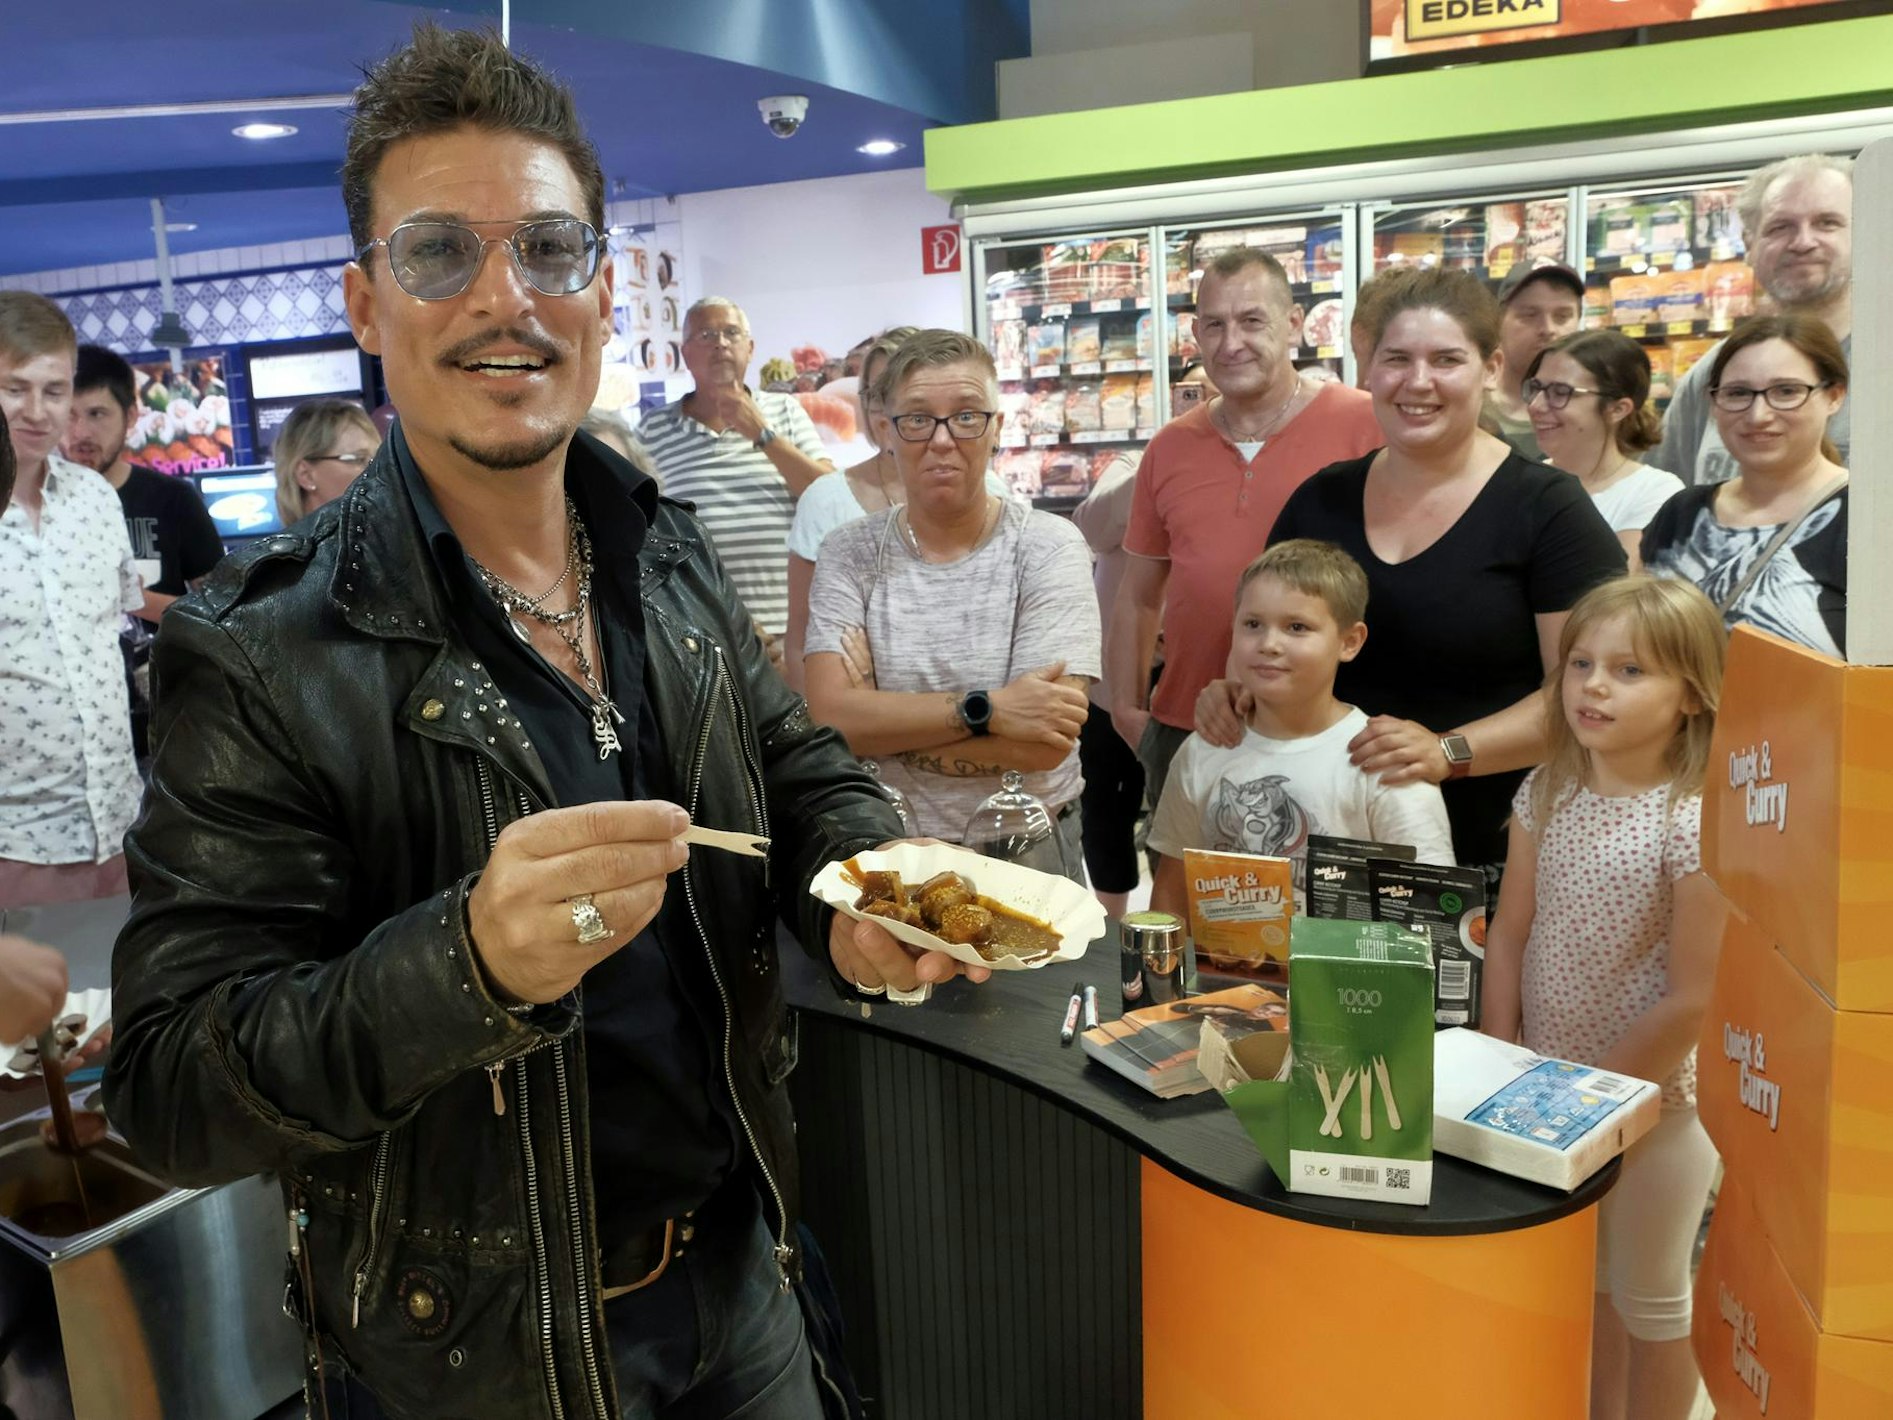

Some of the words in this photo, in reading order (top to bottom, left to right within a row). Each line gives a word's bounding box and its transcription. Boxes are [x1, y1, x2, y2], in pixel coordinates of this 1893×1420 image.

[1729, 745, 1759, 791] Quick
[1761, 740, 1772, 780] &
[1746, 779, 1788, 833] Curry
[1195, 874, 1241, 894] Quick
[1245, 871, 1259, 887] &
[1324, 871, 1347, 881] Curry
[1223, 885, 1282, 906] Curry
[1337, 987, 1382, 1007] 1000
[1724, 1022, 1752, 1068] Quick
[1755, 1033, 1766, 1072] &
[1740, 1061, 1781, 1132] Curry
